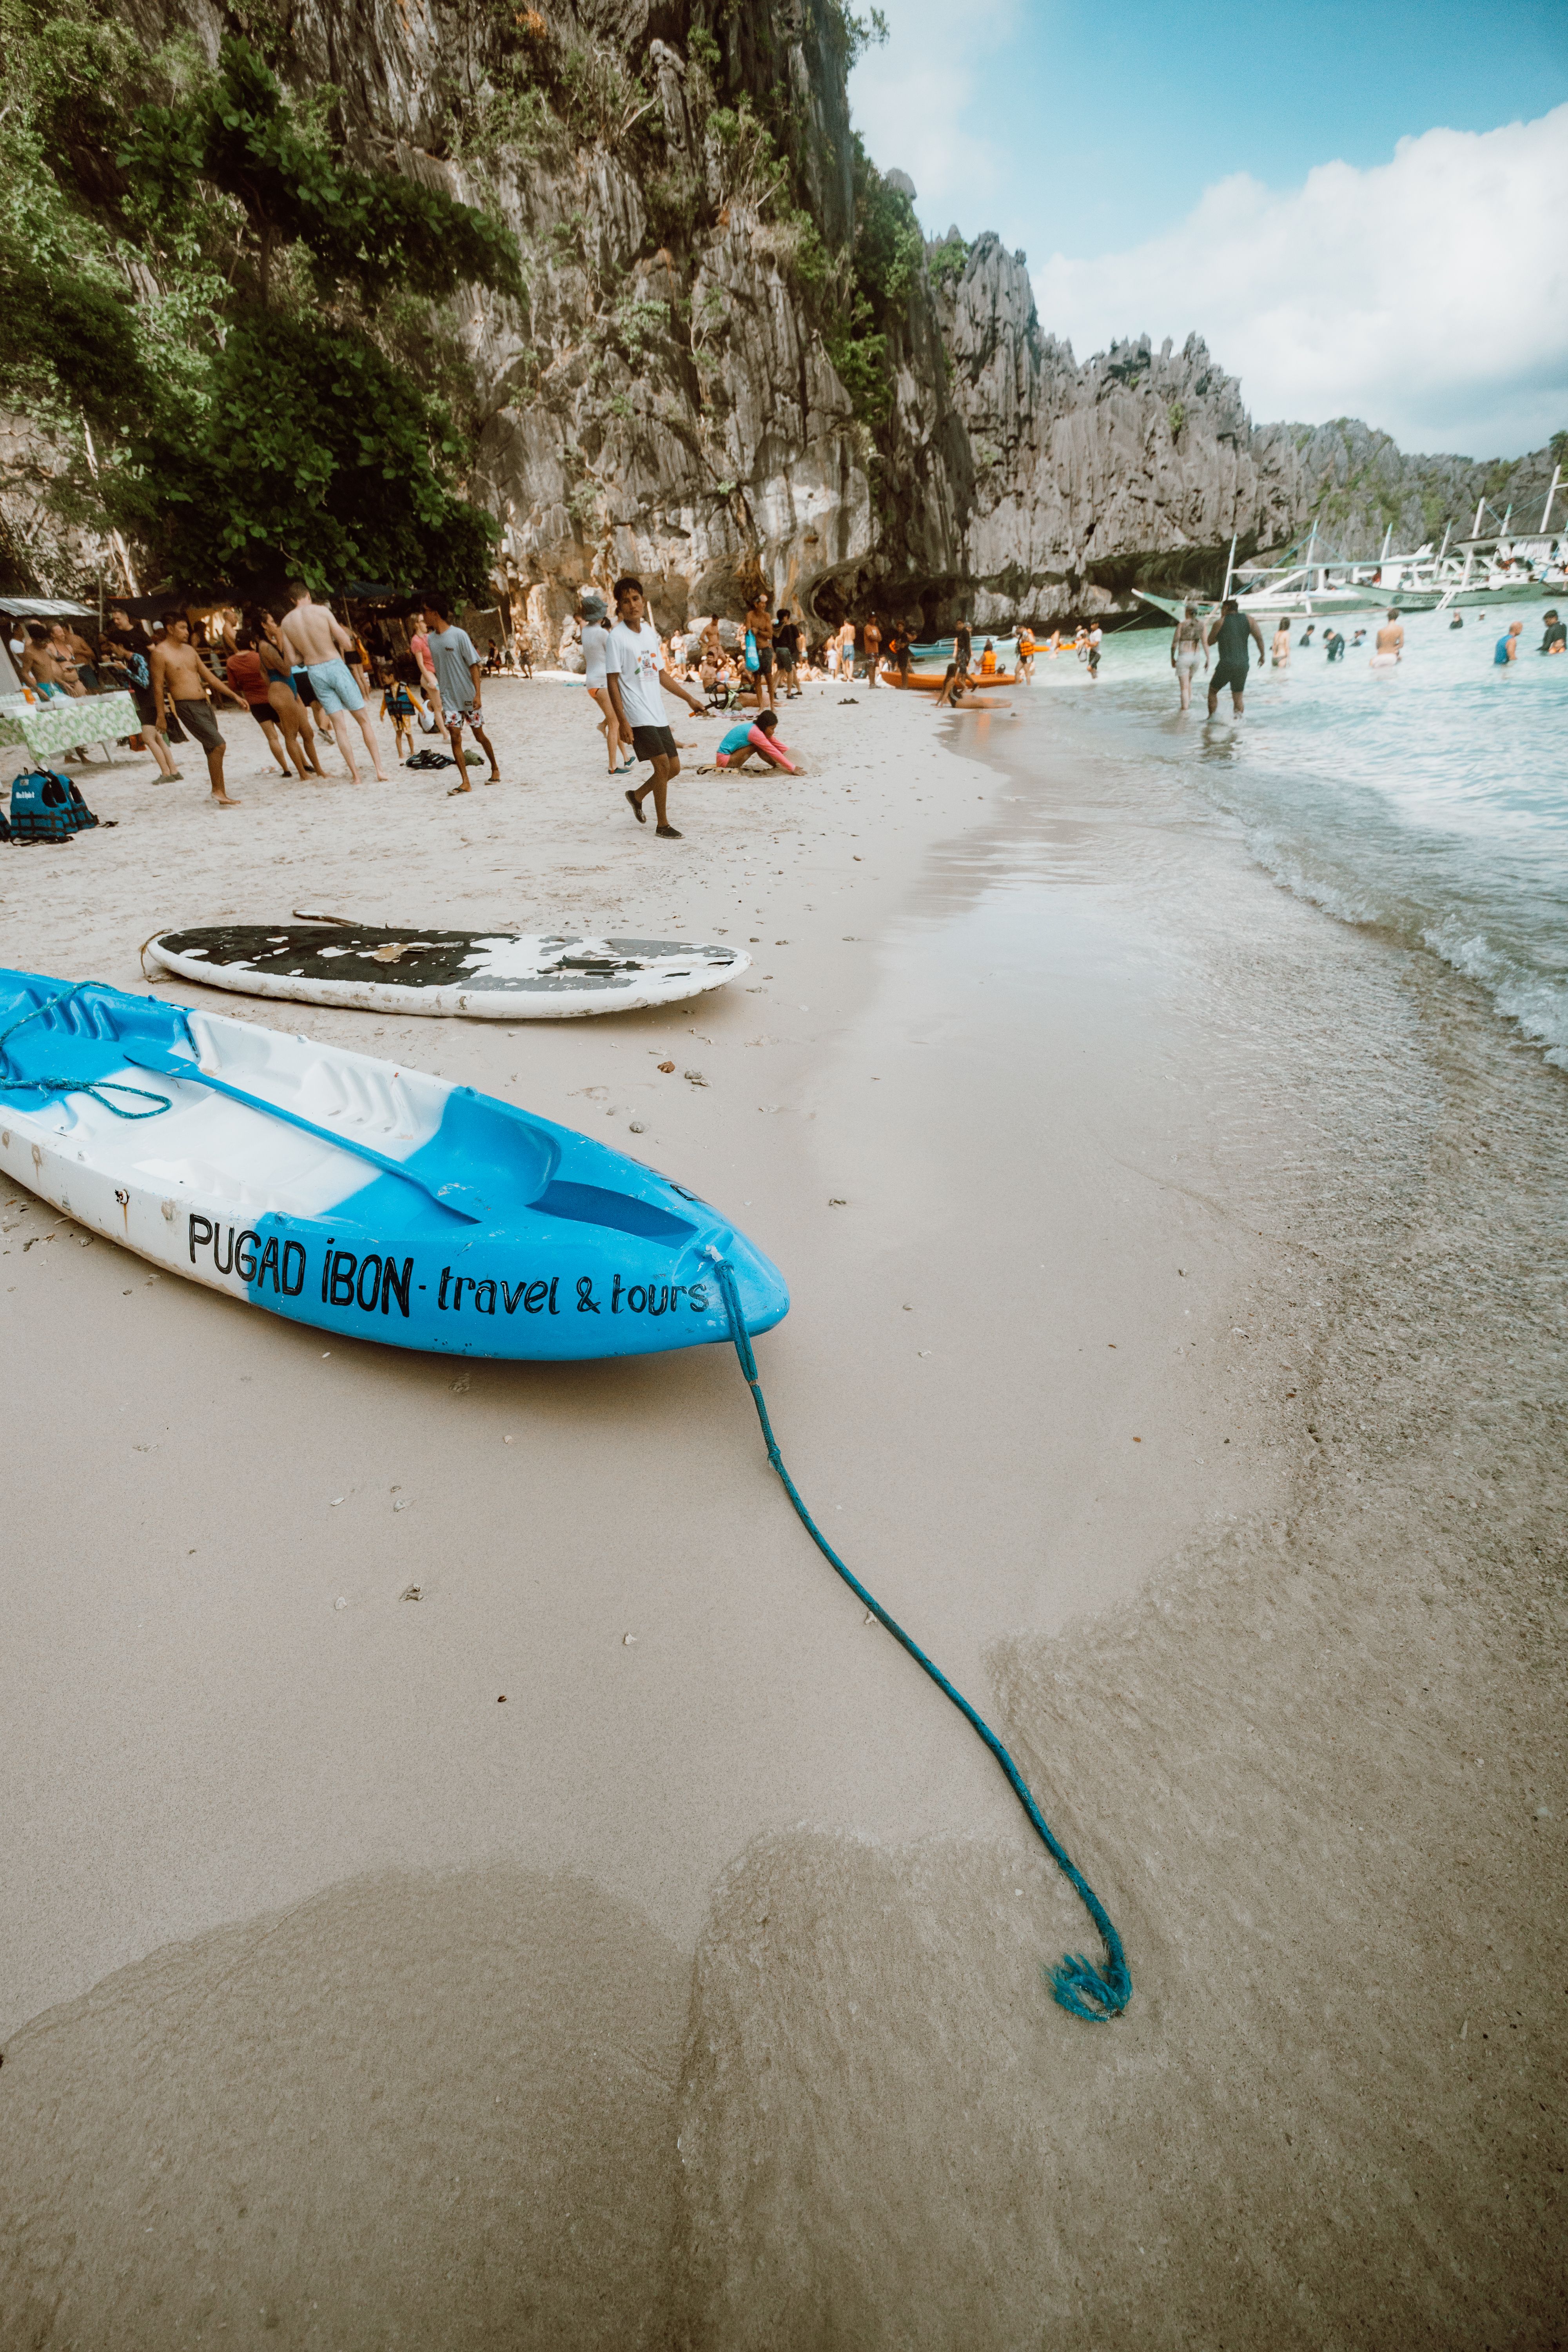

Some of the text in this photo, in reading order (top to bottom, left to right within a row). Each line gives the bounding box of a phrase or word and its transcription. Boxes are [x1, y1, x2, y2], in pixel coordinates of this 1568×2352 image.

[189, 1214, 306, 1296] PUGAD
[438, 1266, 561, 1315] travel
[577, 1276, 601, 1314] &
[612, 1274, 709, 1316] tours
